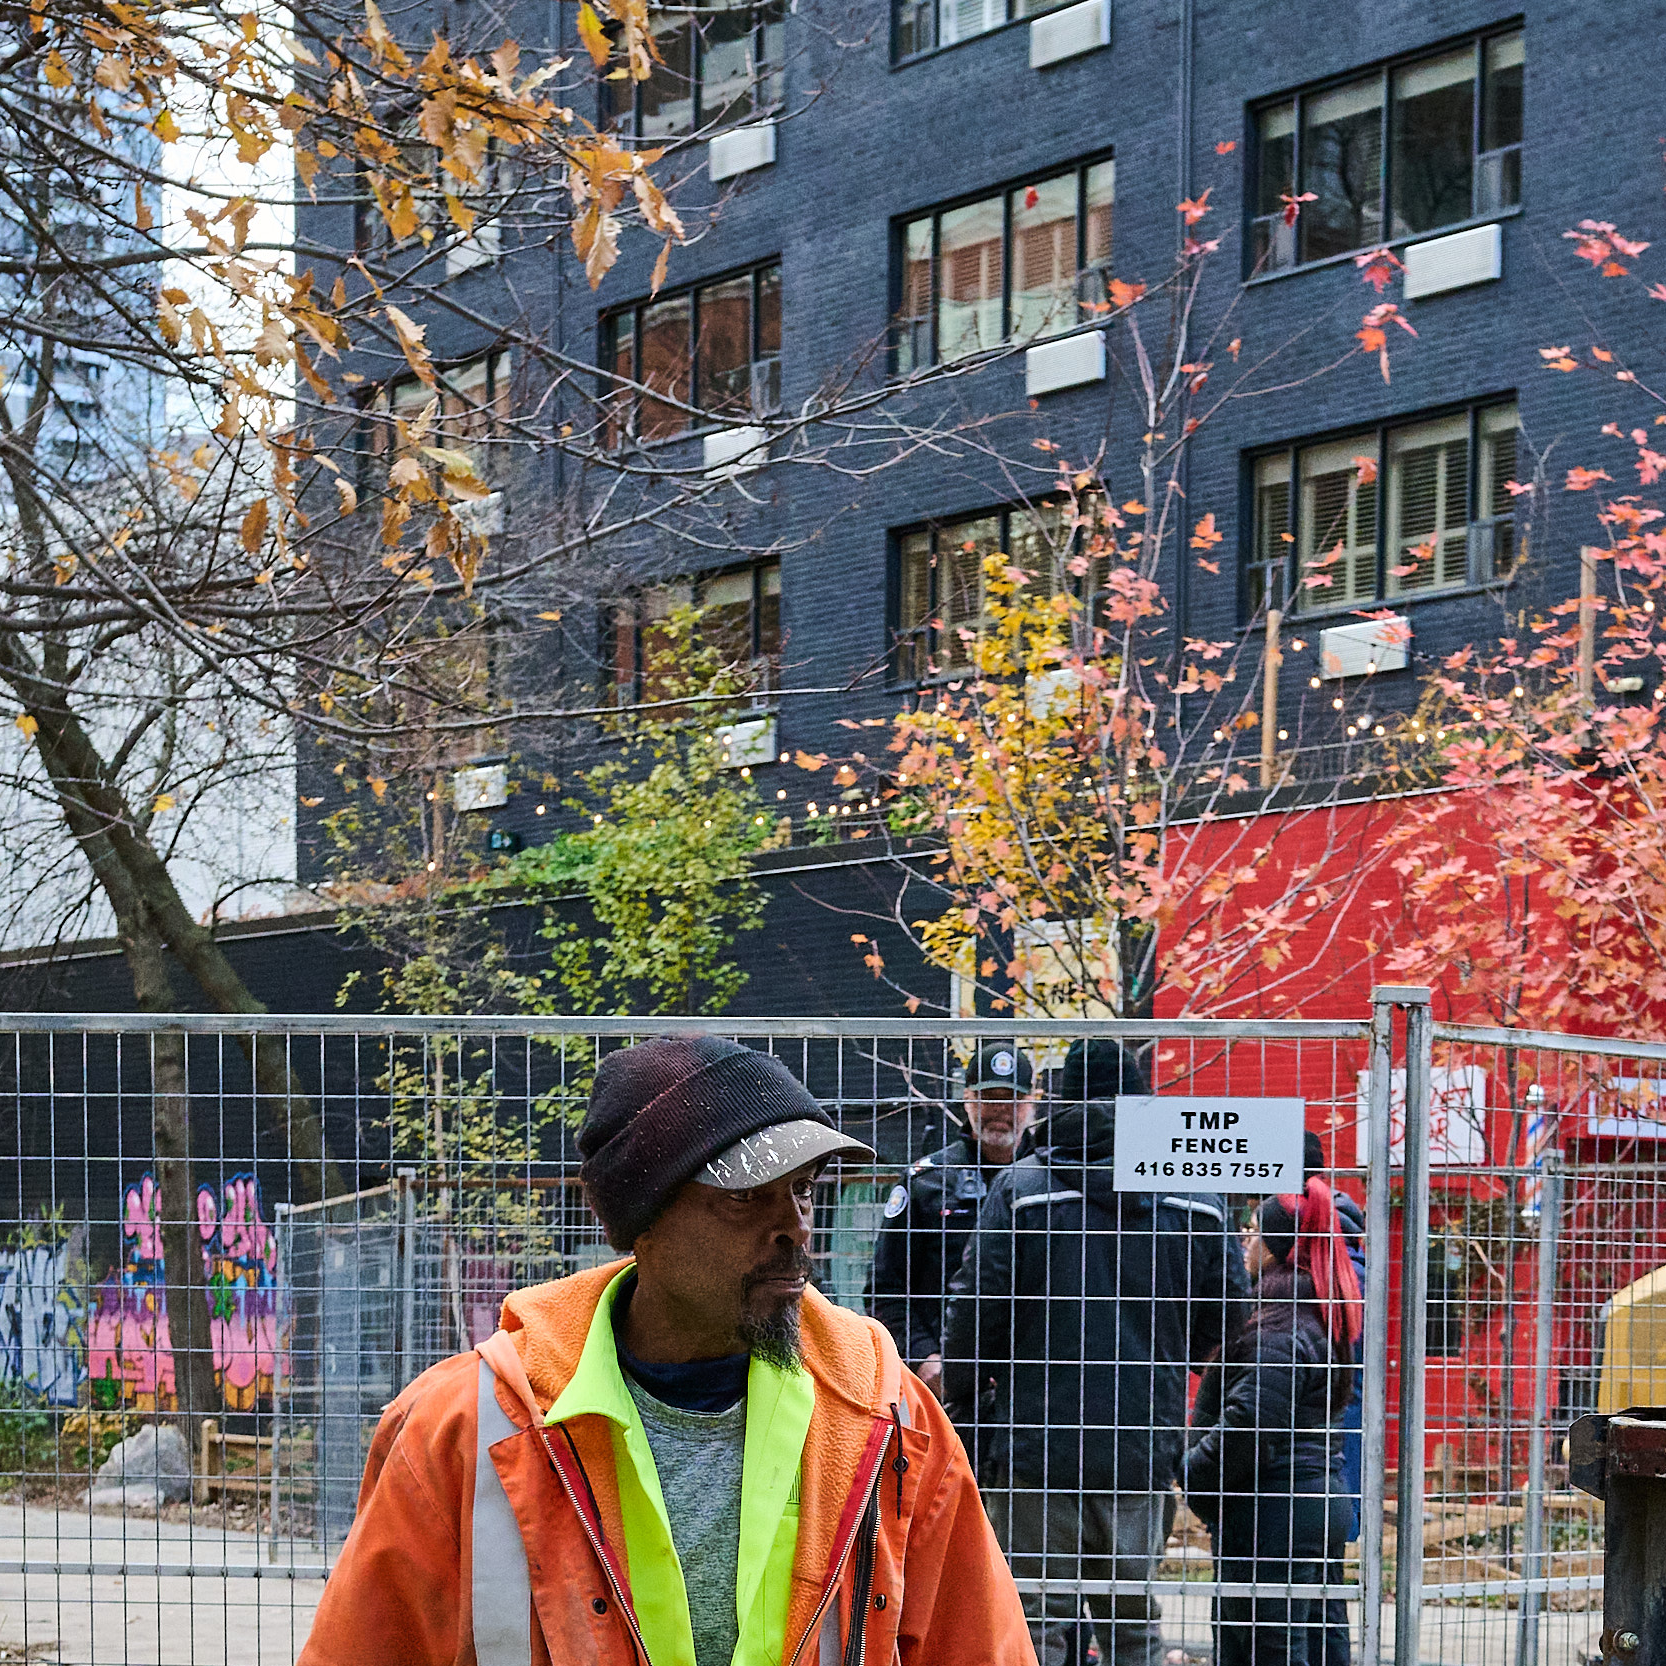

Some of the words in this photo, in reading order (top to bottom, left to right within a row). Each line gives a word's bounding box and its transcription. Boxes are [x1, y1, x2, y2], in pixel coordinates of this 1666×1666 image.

[1180, 1111, 1240, 1130] TMP
[1171, 1138, 1248, 1153] FENCE
[1134, 1161, 1175, 1177] 416
[1182, 1162, 1222, 1177] 835
[1230, 1163, 1284, 1178] 7557
